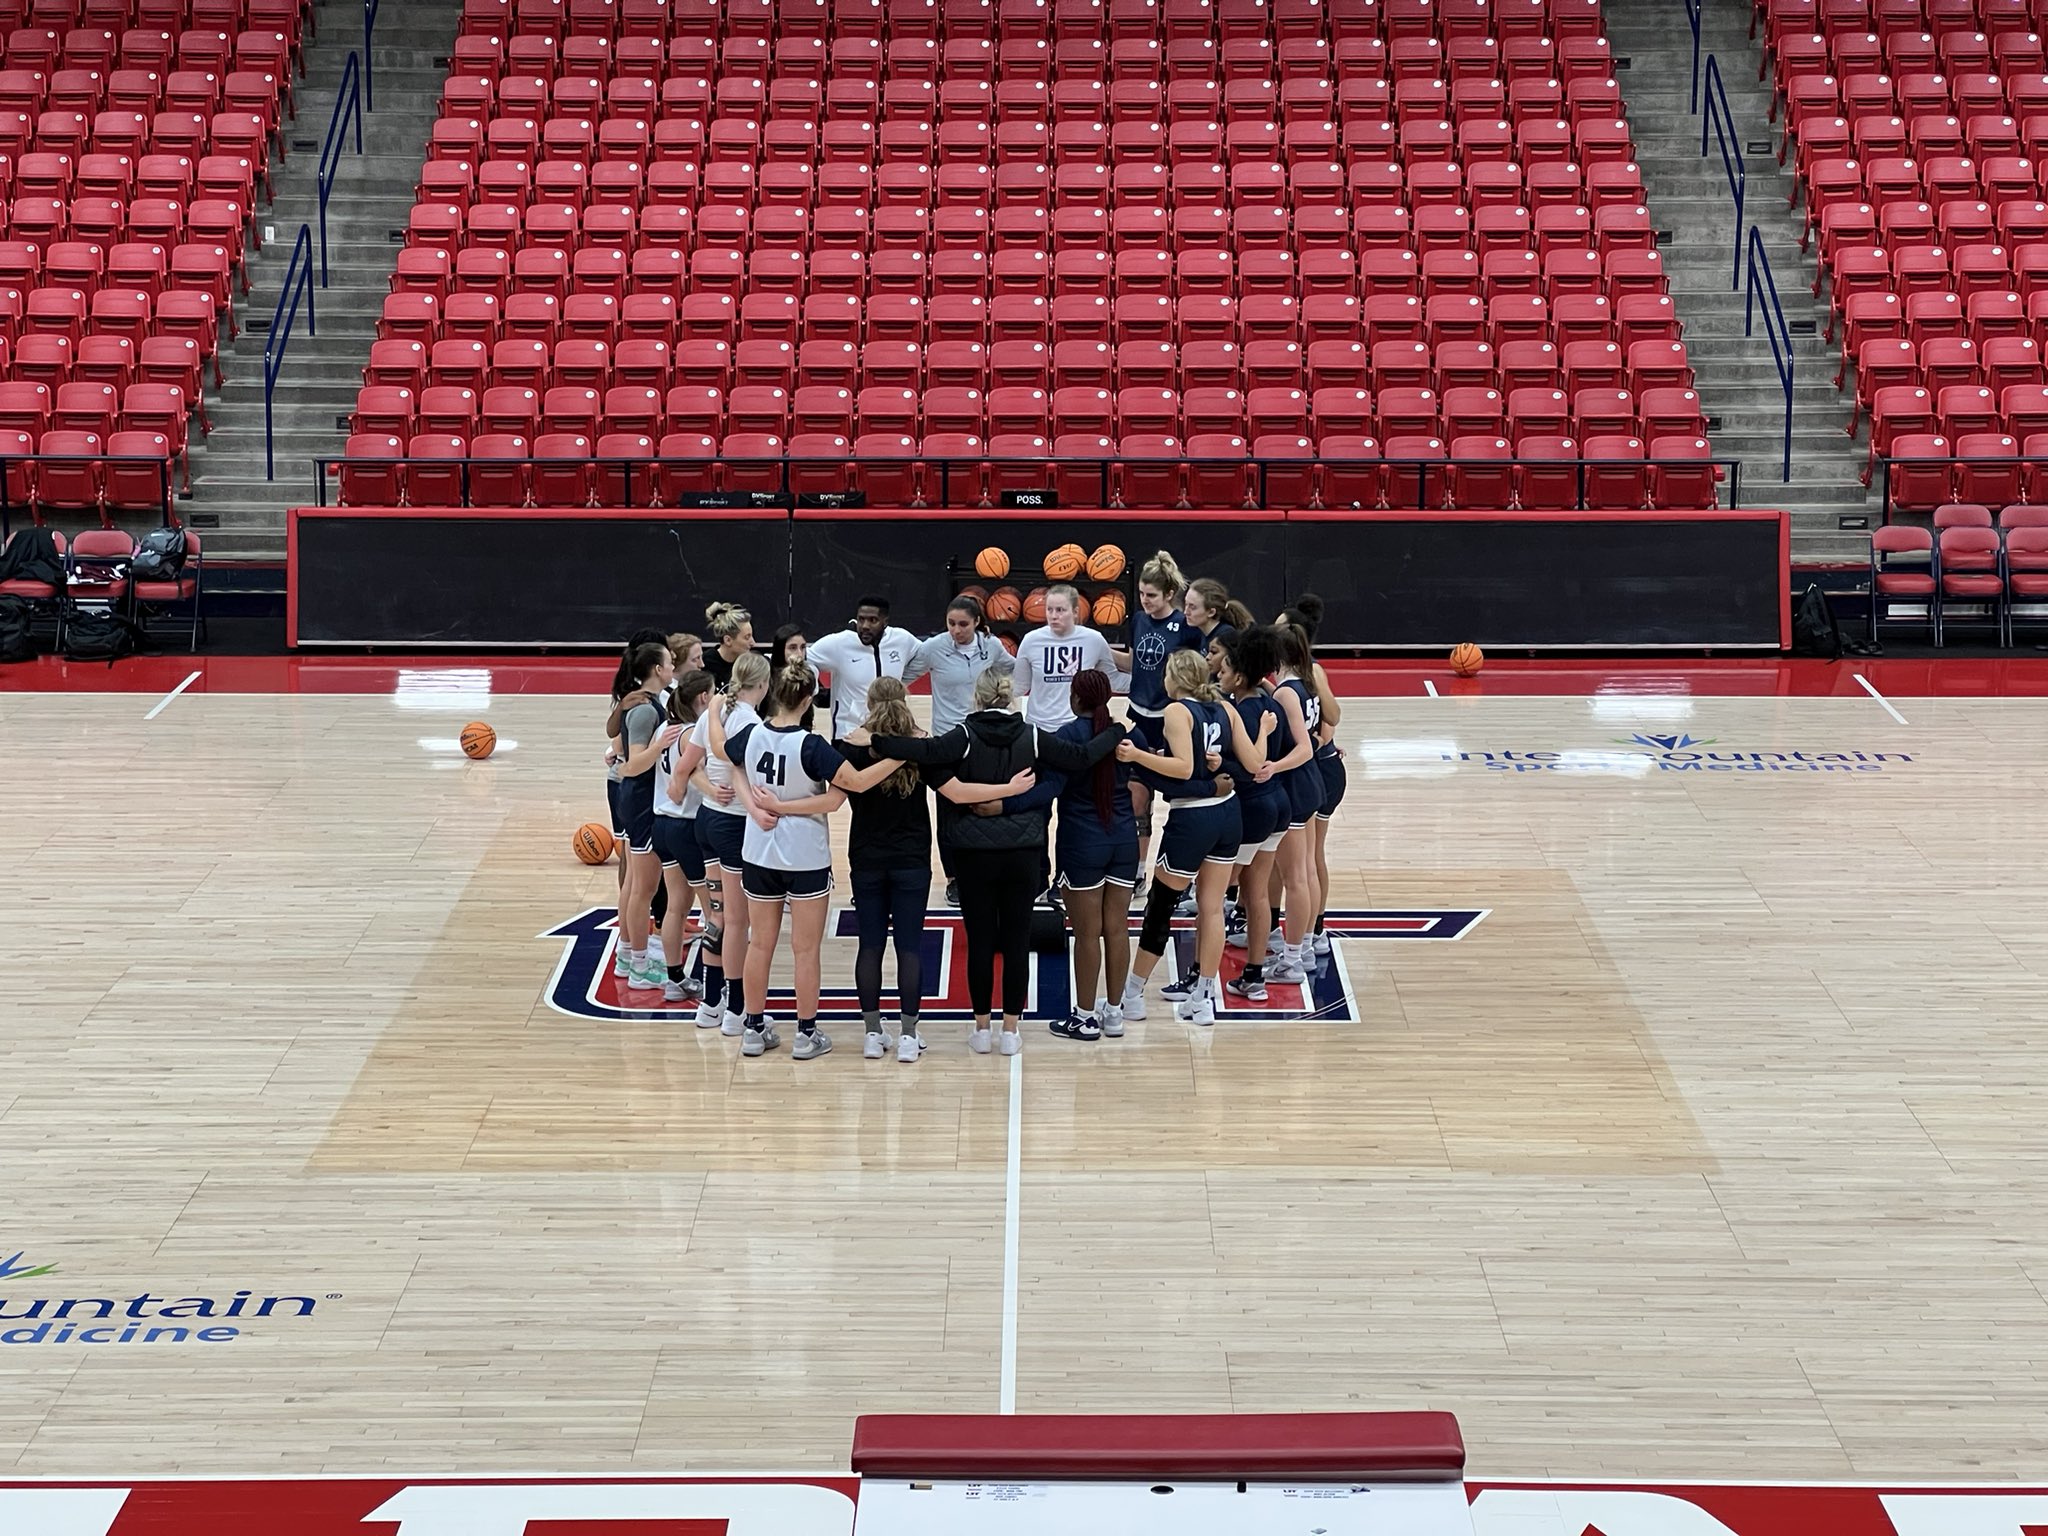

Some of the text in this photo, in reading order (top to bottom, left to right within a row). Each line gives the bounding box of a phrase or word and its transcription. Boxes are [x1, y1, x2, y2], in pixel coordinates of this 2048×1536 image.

[1016, 495, 1043, 504] POSS.
[1166, 622, 1179, 631] 43
[1203, 721, 1222, 752] 12
[1441, 750, 1913, 762] ntemountain
[756, 751, 787, 786] 41
[1659, 762, 1883, 772] Medicine
[583, 831, 600, 857] Wilson
[0, 1322, 240, 1344] dicine
